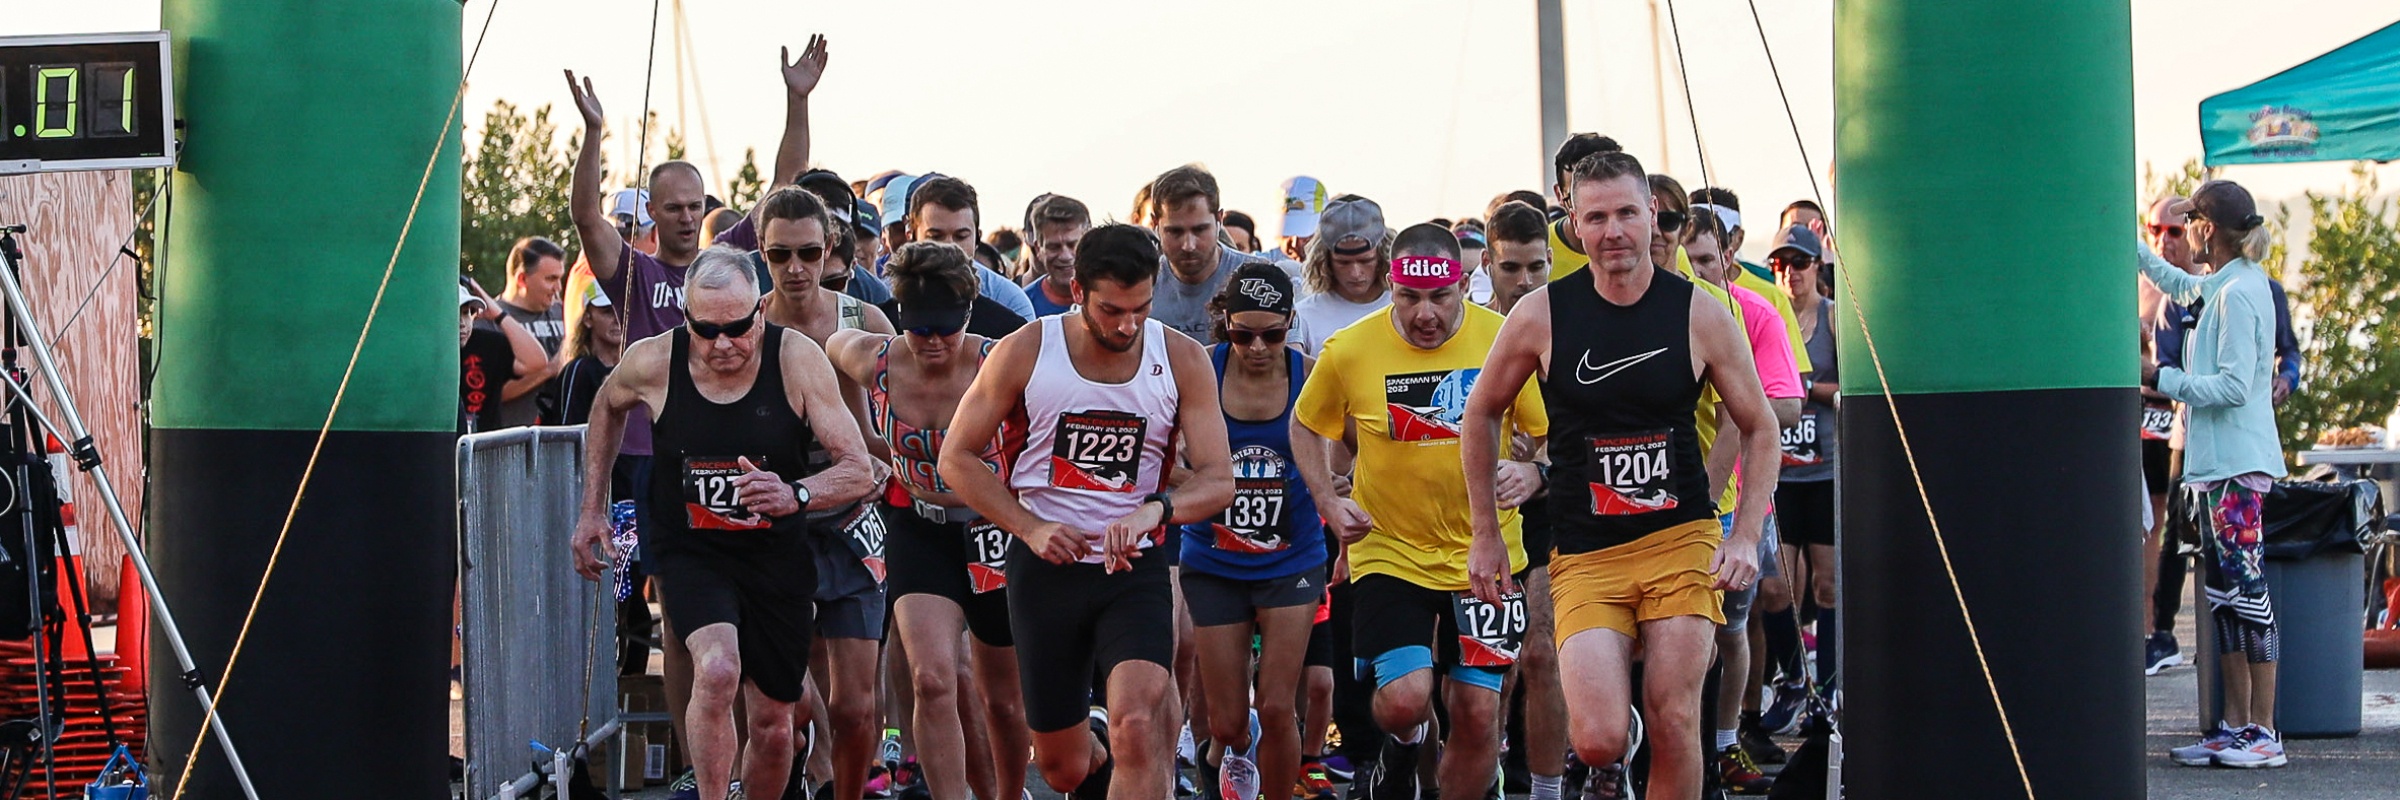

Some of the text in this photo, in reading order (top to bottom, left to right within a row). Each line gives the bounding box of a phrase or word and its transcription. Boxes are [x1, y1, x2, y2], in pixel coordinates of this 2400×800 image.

[1401, 258, 1450, 277] idiot
[1240, 278, 1283, 308] UCF
[1386, 376, 1430, 386] SPACEMAN
[1387, 385, 1409, 393] 2023
[1065, 423, 1104, 433] FEBRUARY
[2141, 411, 2176, 428] 133
[1067, 430, 1137, 462] 1223
[1594, 445, 1634, 453] FEBRUARY
[1647, 441, 1667, 449] 2023
[1599, 448, 1670, 486] 1204
[694, 475, 741, 507] 127
[1464, 600, 1526, 638] 1279
